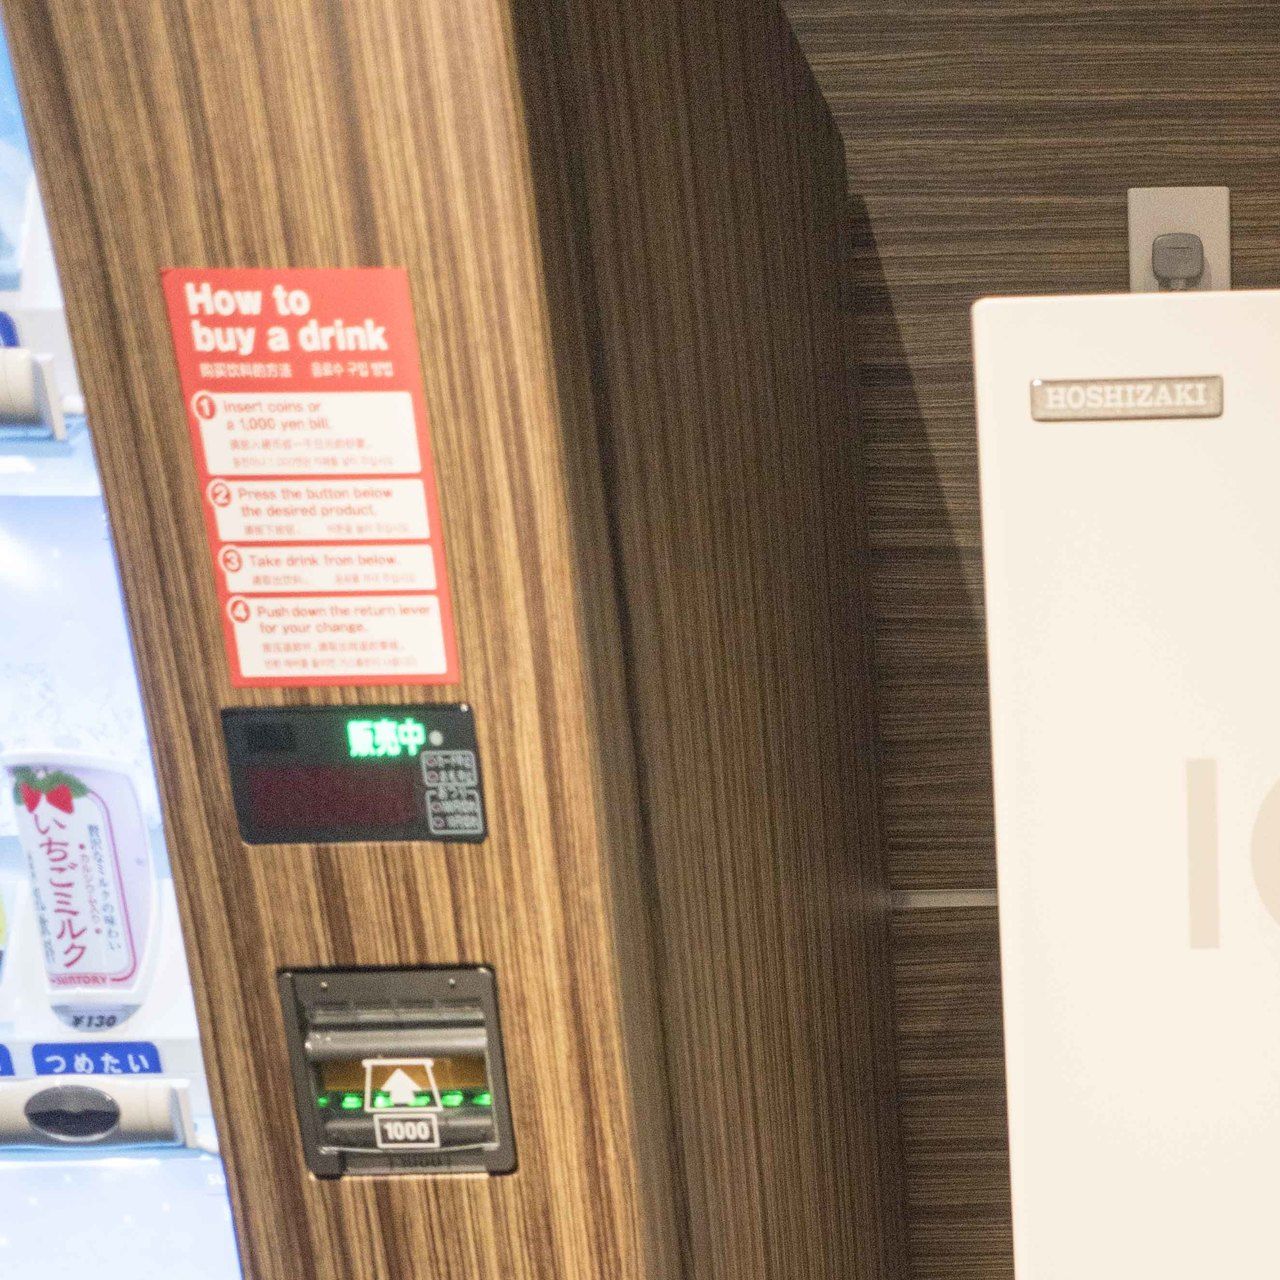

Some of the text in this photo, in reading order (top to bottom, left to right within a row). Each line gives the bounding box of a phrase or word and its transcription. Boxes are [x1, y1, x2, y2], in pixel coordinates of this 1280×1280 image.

[184, 281, 312, 316] How to
[191, 318, 389, 356] buy a drink
[1045, 381, 1208, 410] HOSHIZAKI
[223, 401, 322, 414] Insert coins or
[227, 420, 235, 430] a
[240, 418, 276, 432] 1,000
[281, 420, 304, 433] yen
[238, 487, 393, 500] Press the button below
[241, 506, 262, 517] the
[267, 505, 317, 517] desired
[249, 555, 282, 567] Take
[287, 554, 318, 566] drink
[324, 554, 353, 566] from
[257, 604, 431, 618] Push down the return lever
[260, 623, 277, 634] for
[282, 623, 313, 636] your
[347, 718, 426, 757] 販売中
[33, 813, 87, 968] いちごミルク
[56, 974, 107, 985] SUNTORY
[72, 1015, 117, 1028] ¥130
[45, 1053, 150, 1075] つめたい
[383, 1121, 429, 1142] 1000
